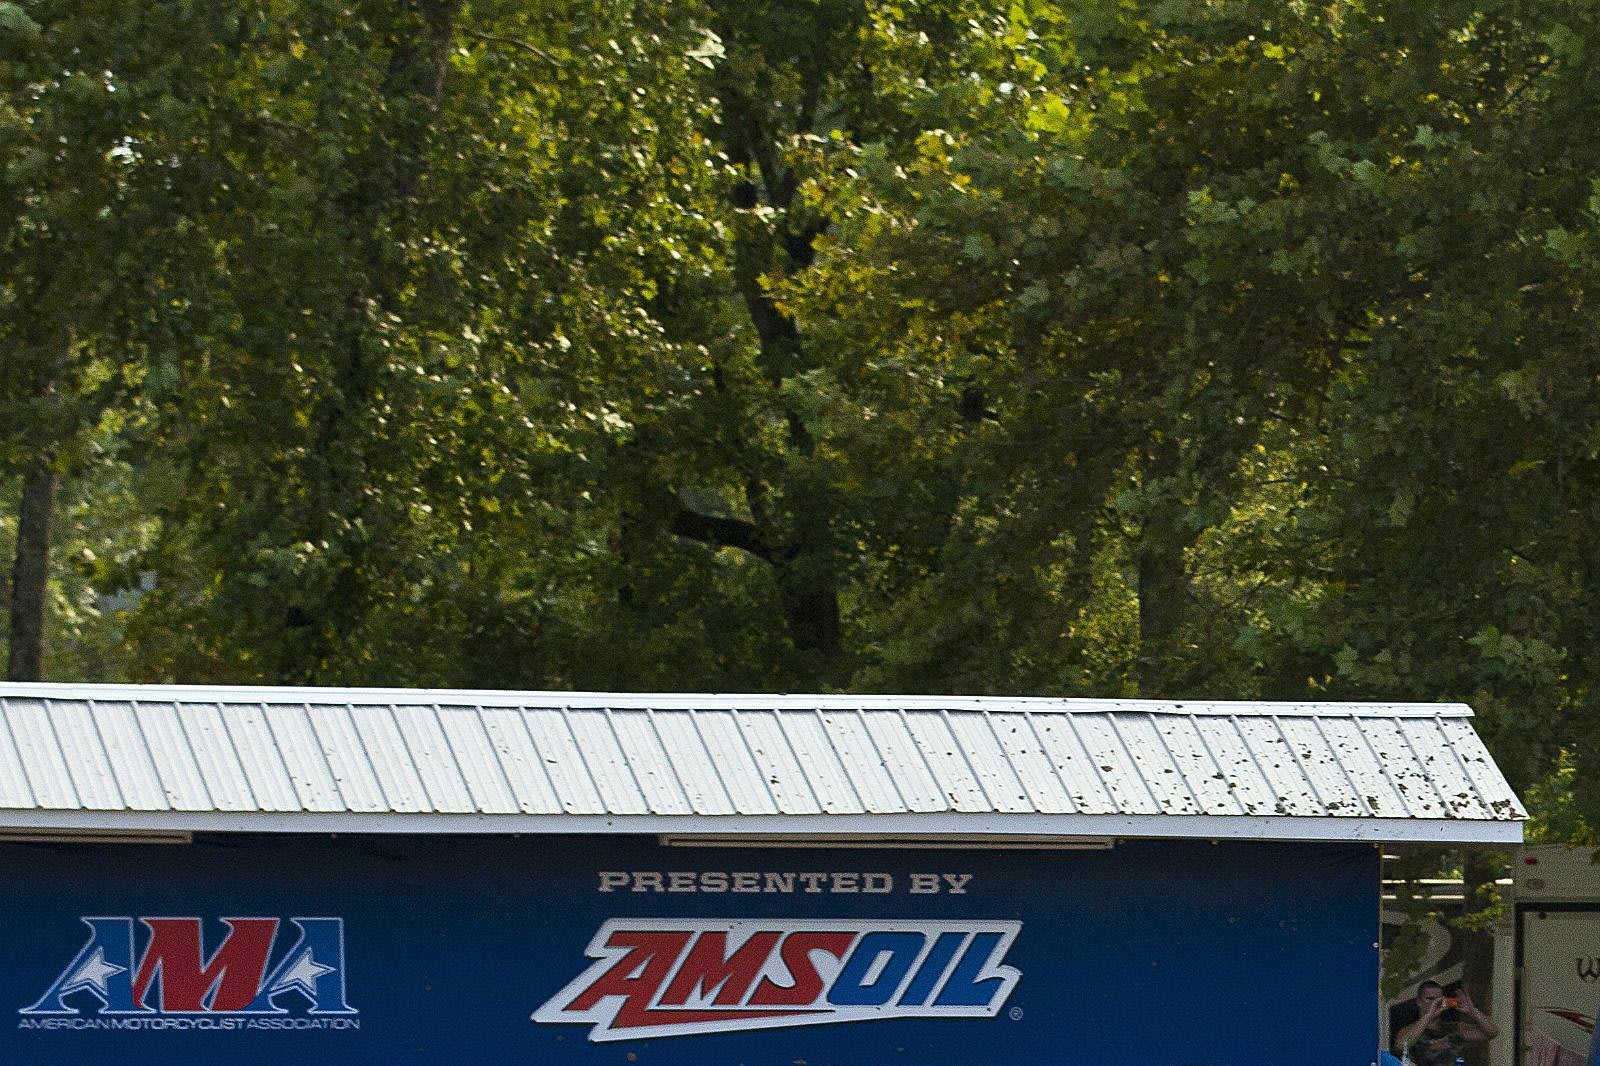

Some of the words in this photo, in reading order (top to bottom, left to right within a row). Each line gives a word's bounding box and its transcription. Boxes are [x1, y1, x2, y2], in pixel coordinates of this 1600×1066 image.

[599, 872, 893, 893] PRESENTED
[909, 873, 973, 893] BY
[19, 916, 359, 1015] AMA
[536, 921, 1020, 1039] AMSOIL
[18, 1018, 109, 1030] AMERICAN
[110, 1018, 246, 1030] MOTORCYCLIST
[247, 1018, 360, 1030] ASSOCIATION
